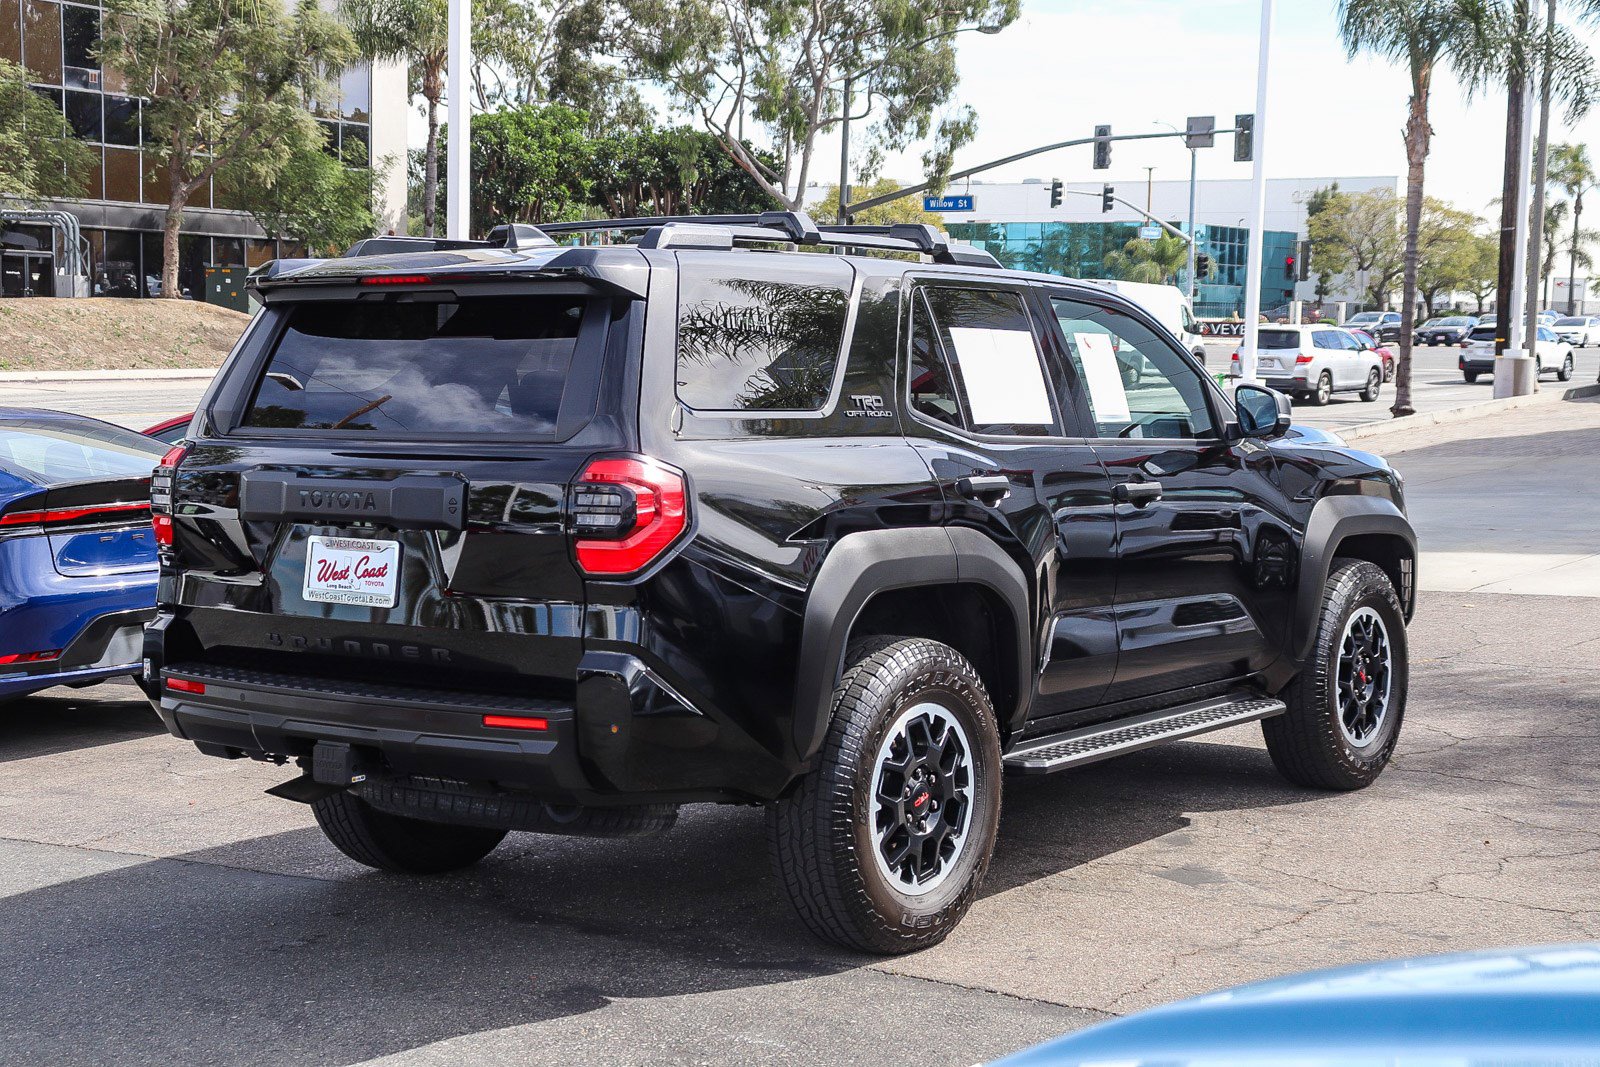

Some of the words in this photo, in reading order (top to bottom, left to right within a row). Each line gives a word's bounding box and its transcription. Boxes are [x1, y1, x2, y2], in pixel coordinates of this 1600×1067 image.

[930, 199, 954, 208] Willow
[958, 199, 968, 208] St
[851, 394, 884, 410] TRD
[299, 489, 377, 512] TOYOTA
[331, 540, 350, 549] WEST
[351, 541, 375, 550] COAST
[317, 559, 350, 583] West
[354, 555, 388, 580] Coast
[365, 580, 385, 588] TOYOTA
[308, 591, 391, 605] WestCoastToyotaLB.com
